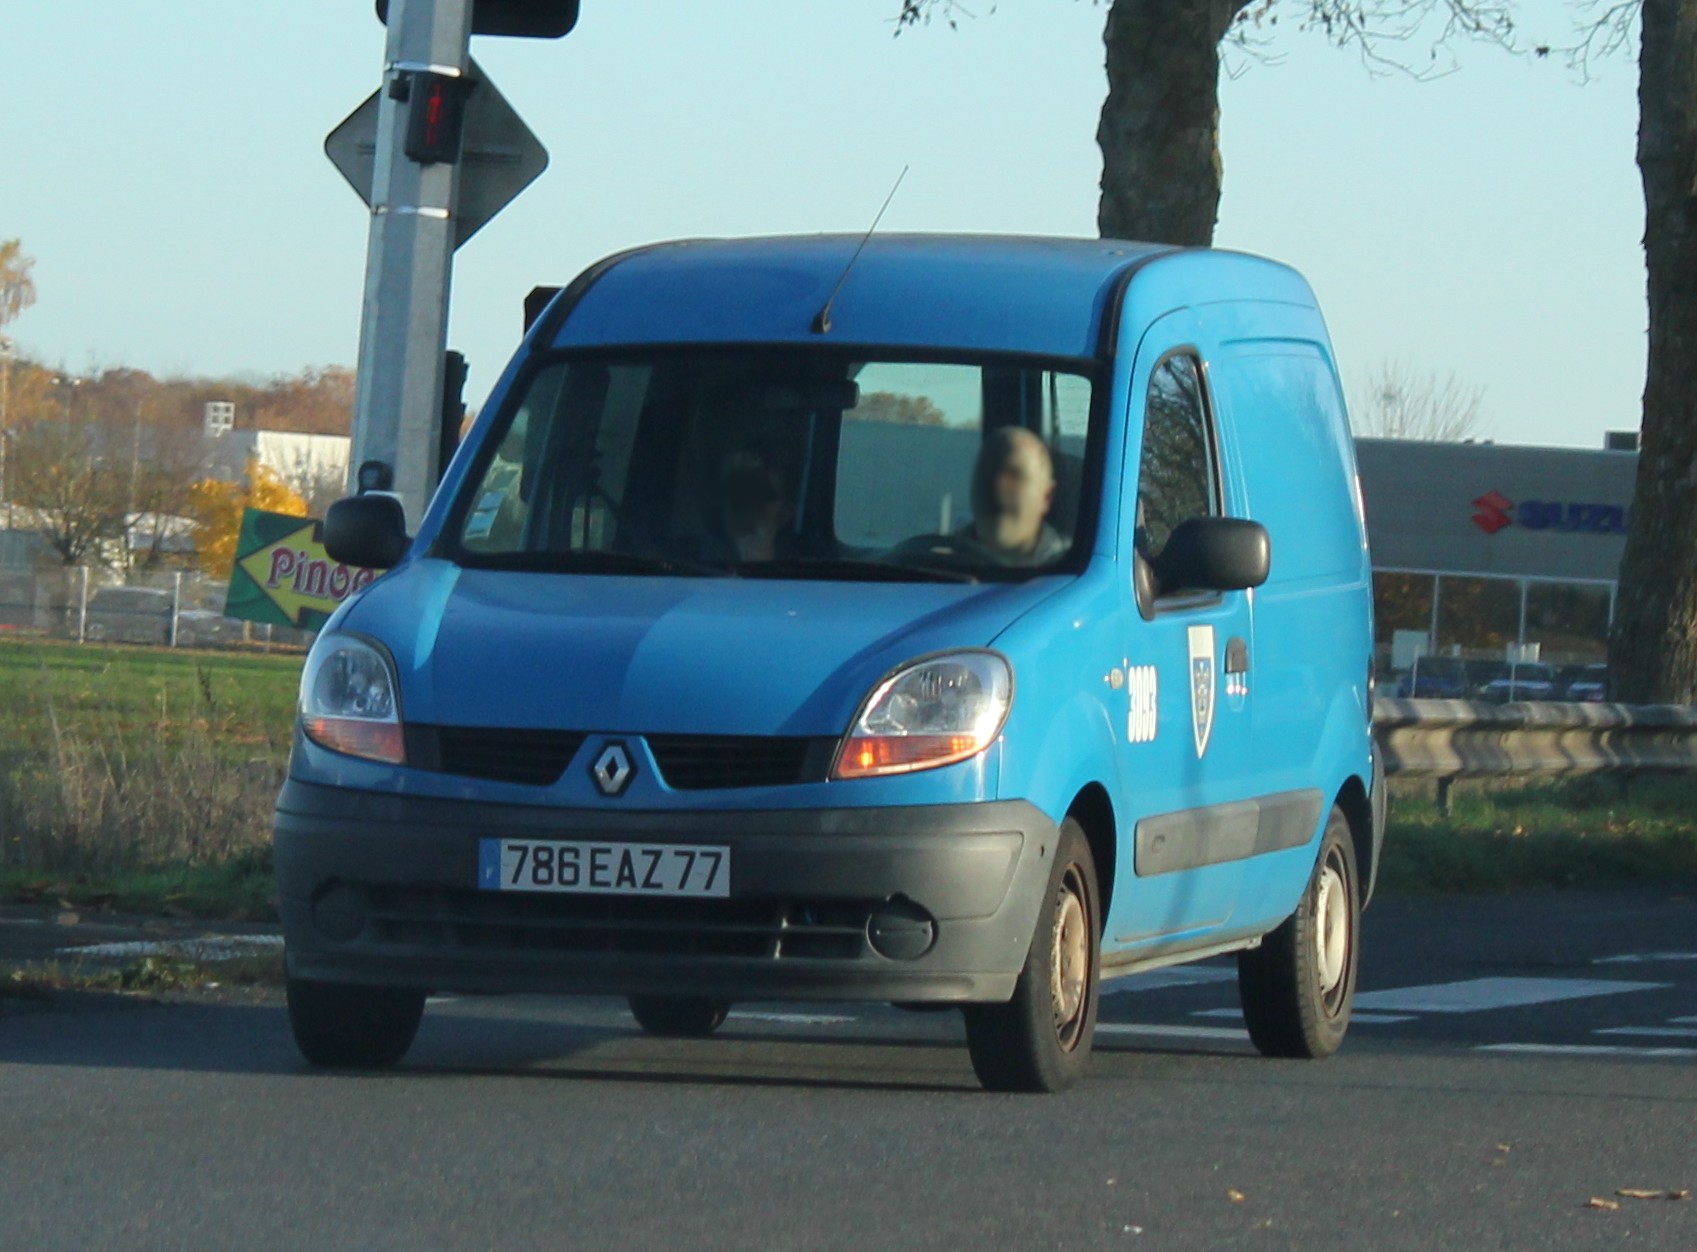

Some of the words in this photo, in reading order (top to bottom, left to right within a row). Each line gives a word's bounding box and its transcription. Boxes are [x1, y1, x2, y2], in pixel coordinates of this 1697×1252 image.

[507, 845, 580, 886] 786
[589, 848, 664, 889] EAZ
[673, 850, 723, 891] 77
